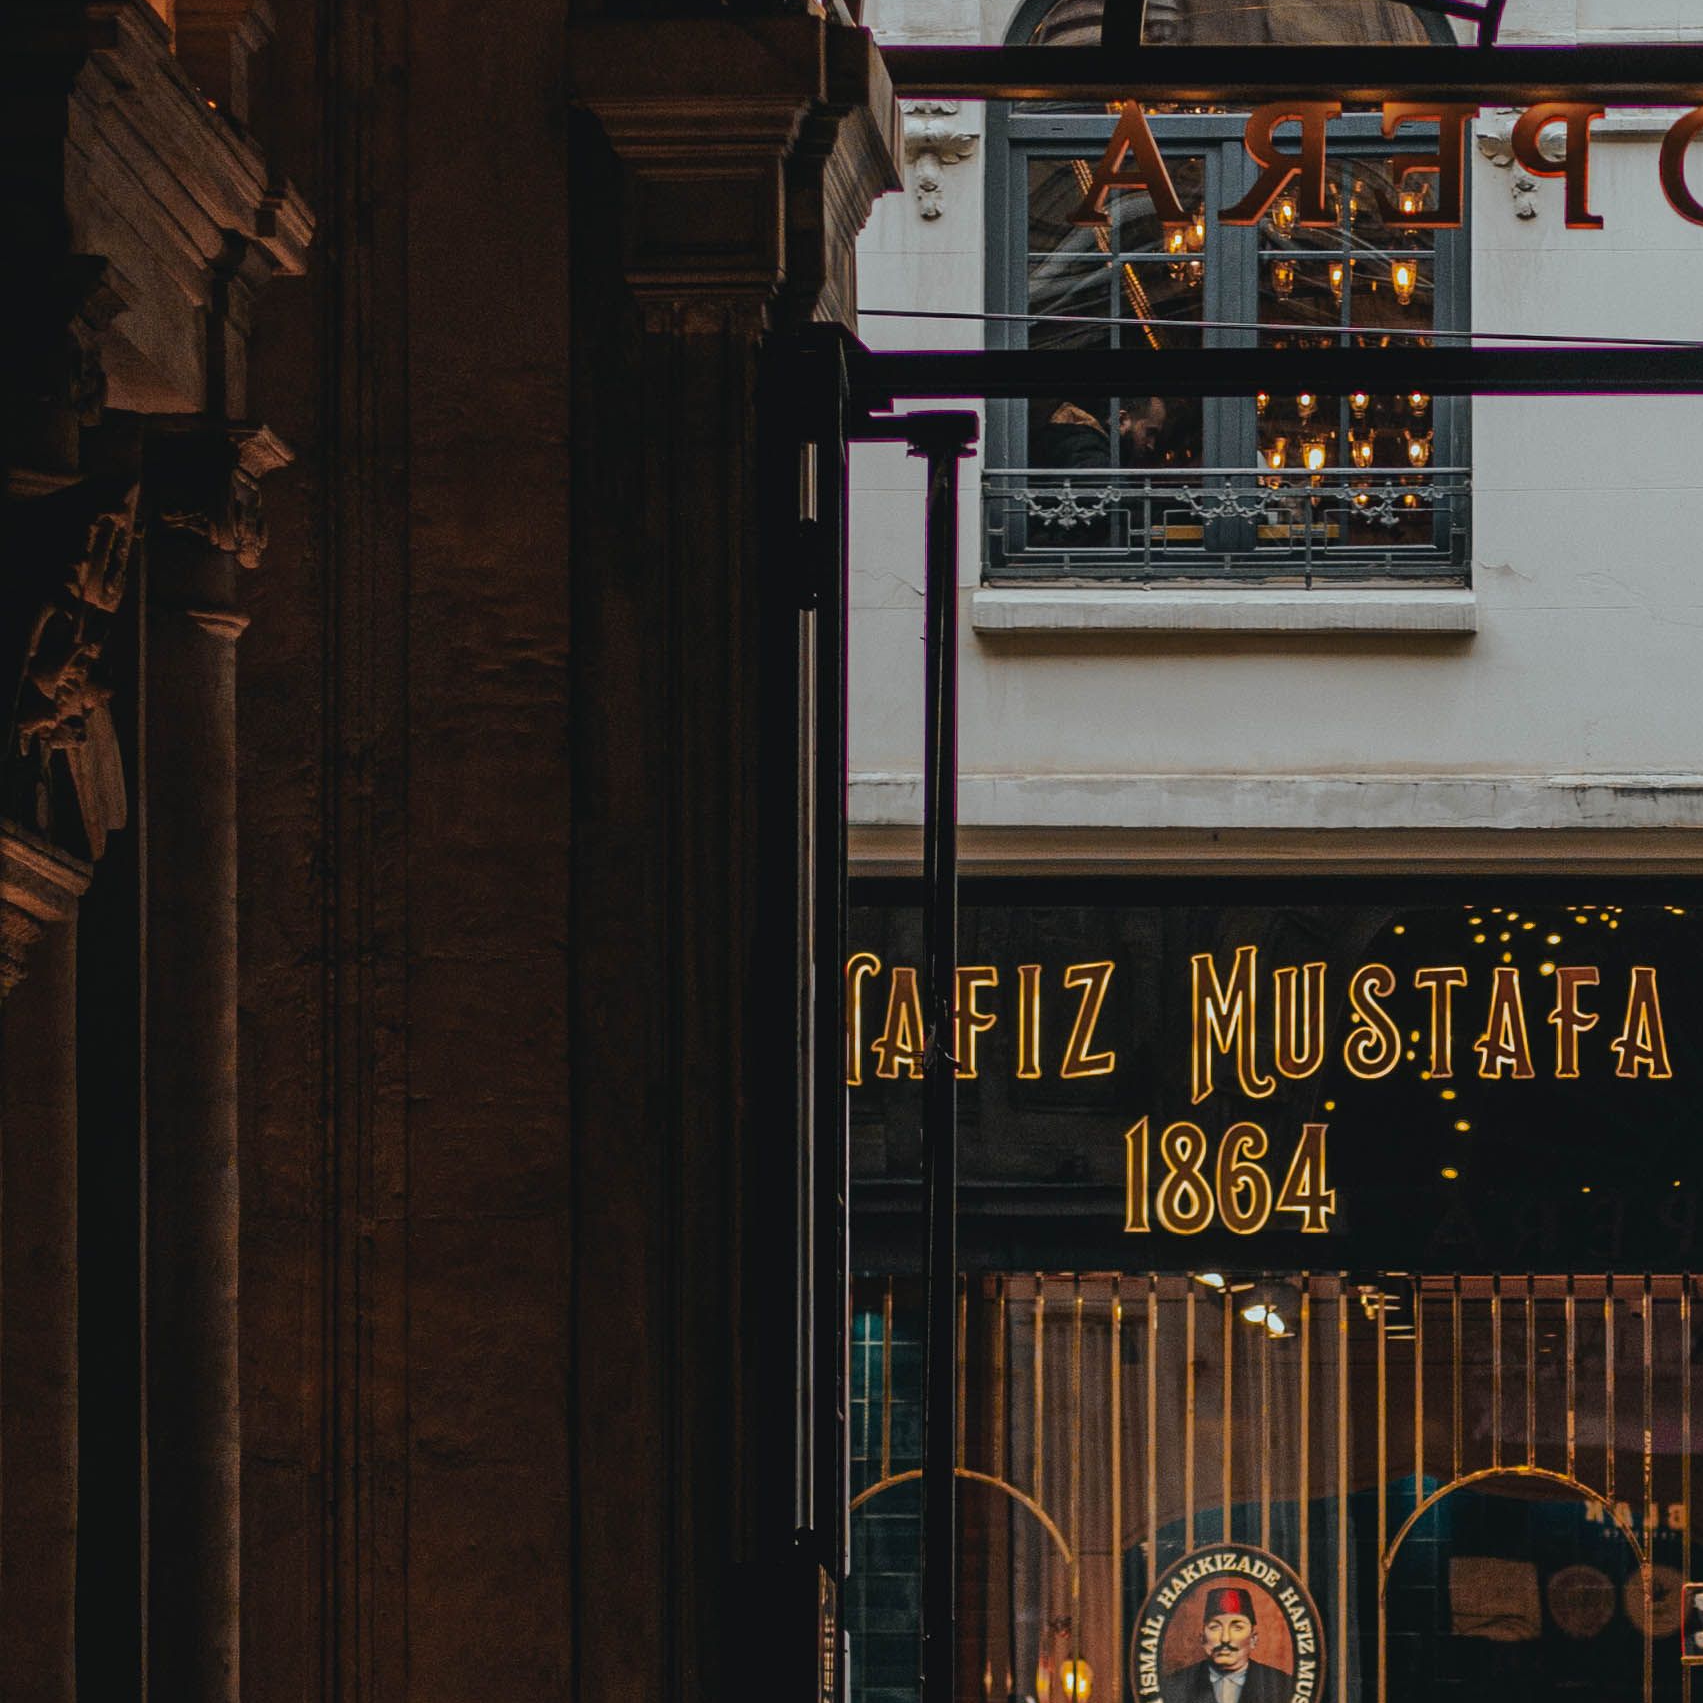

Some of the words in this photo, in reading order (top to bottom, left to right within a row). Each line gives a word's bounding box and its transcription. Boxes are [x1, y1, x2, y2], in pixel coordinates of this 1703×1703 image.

[1190, 945, 1673, 1105] MUSTAFA
[1124, 1115, 1336, 1237] 1864
[1139, 1615, 1164, 1695] İSMAİL
[1156, 1552, 1282, 1610] HAKKIZADE
[1278, 1585, 1317, 1655] HAFIZ
